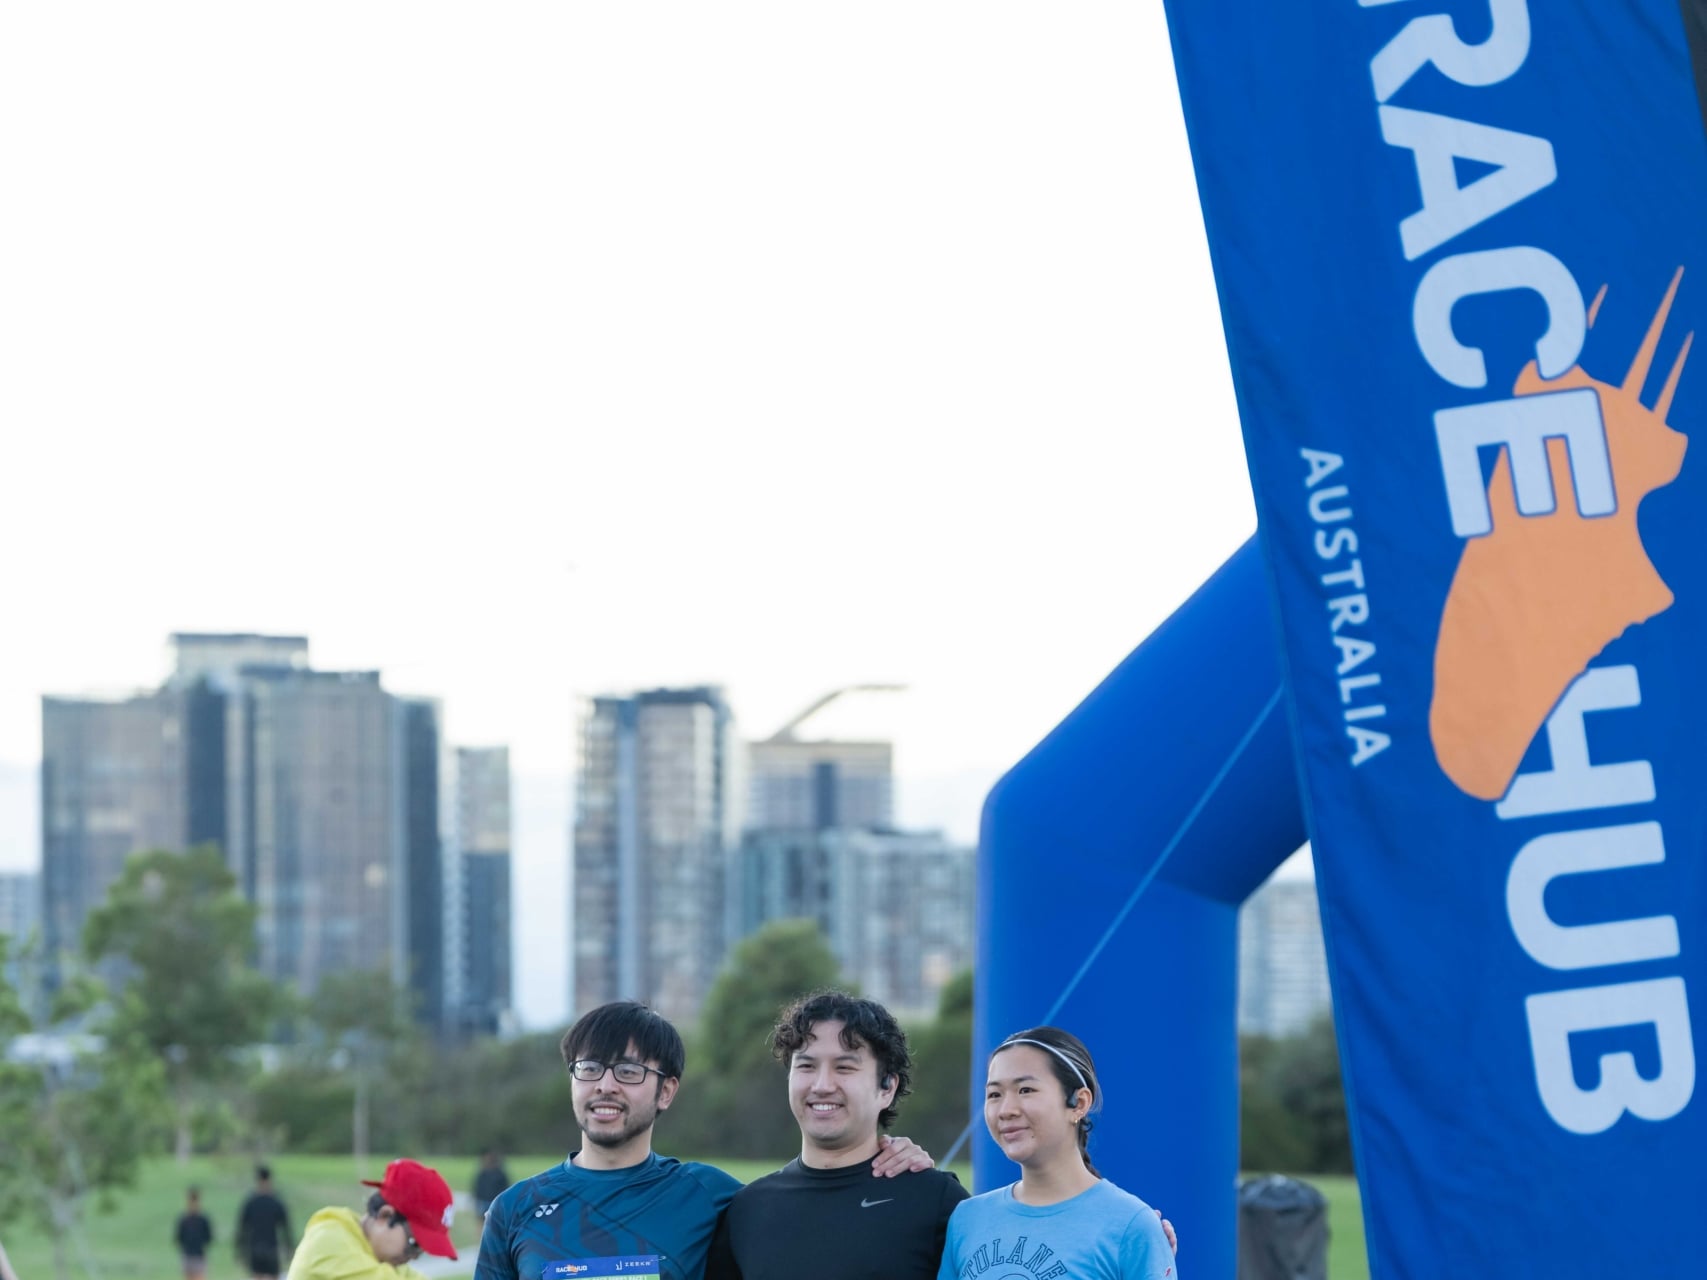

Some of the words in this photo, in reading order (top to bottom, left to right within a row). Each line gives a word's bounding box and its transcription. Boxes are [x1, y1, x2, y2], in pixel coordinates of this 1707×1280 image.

[1299, 447, 1392, 768] AUSTRALIA
[1357, 0, 1618, 538] RACE
[1495, 663, 1697, 1137] HUB
